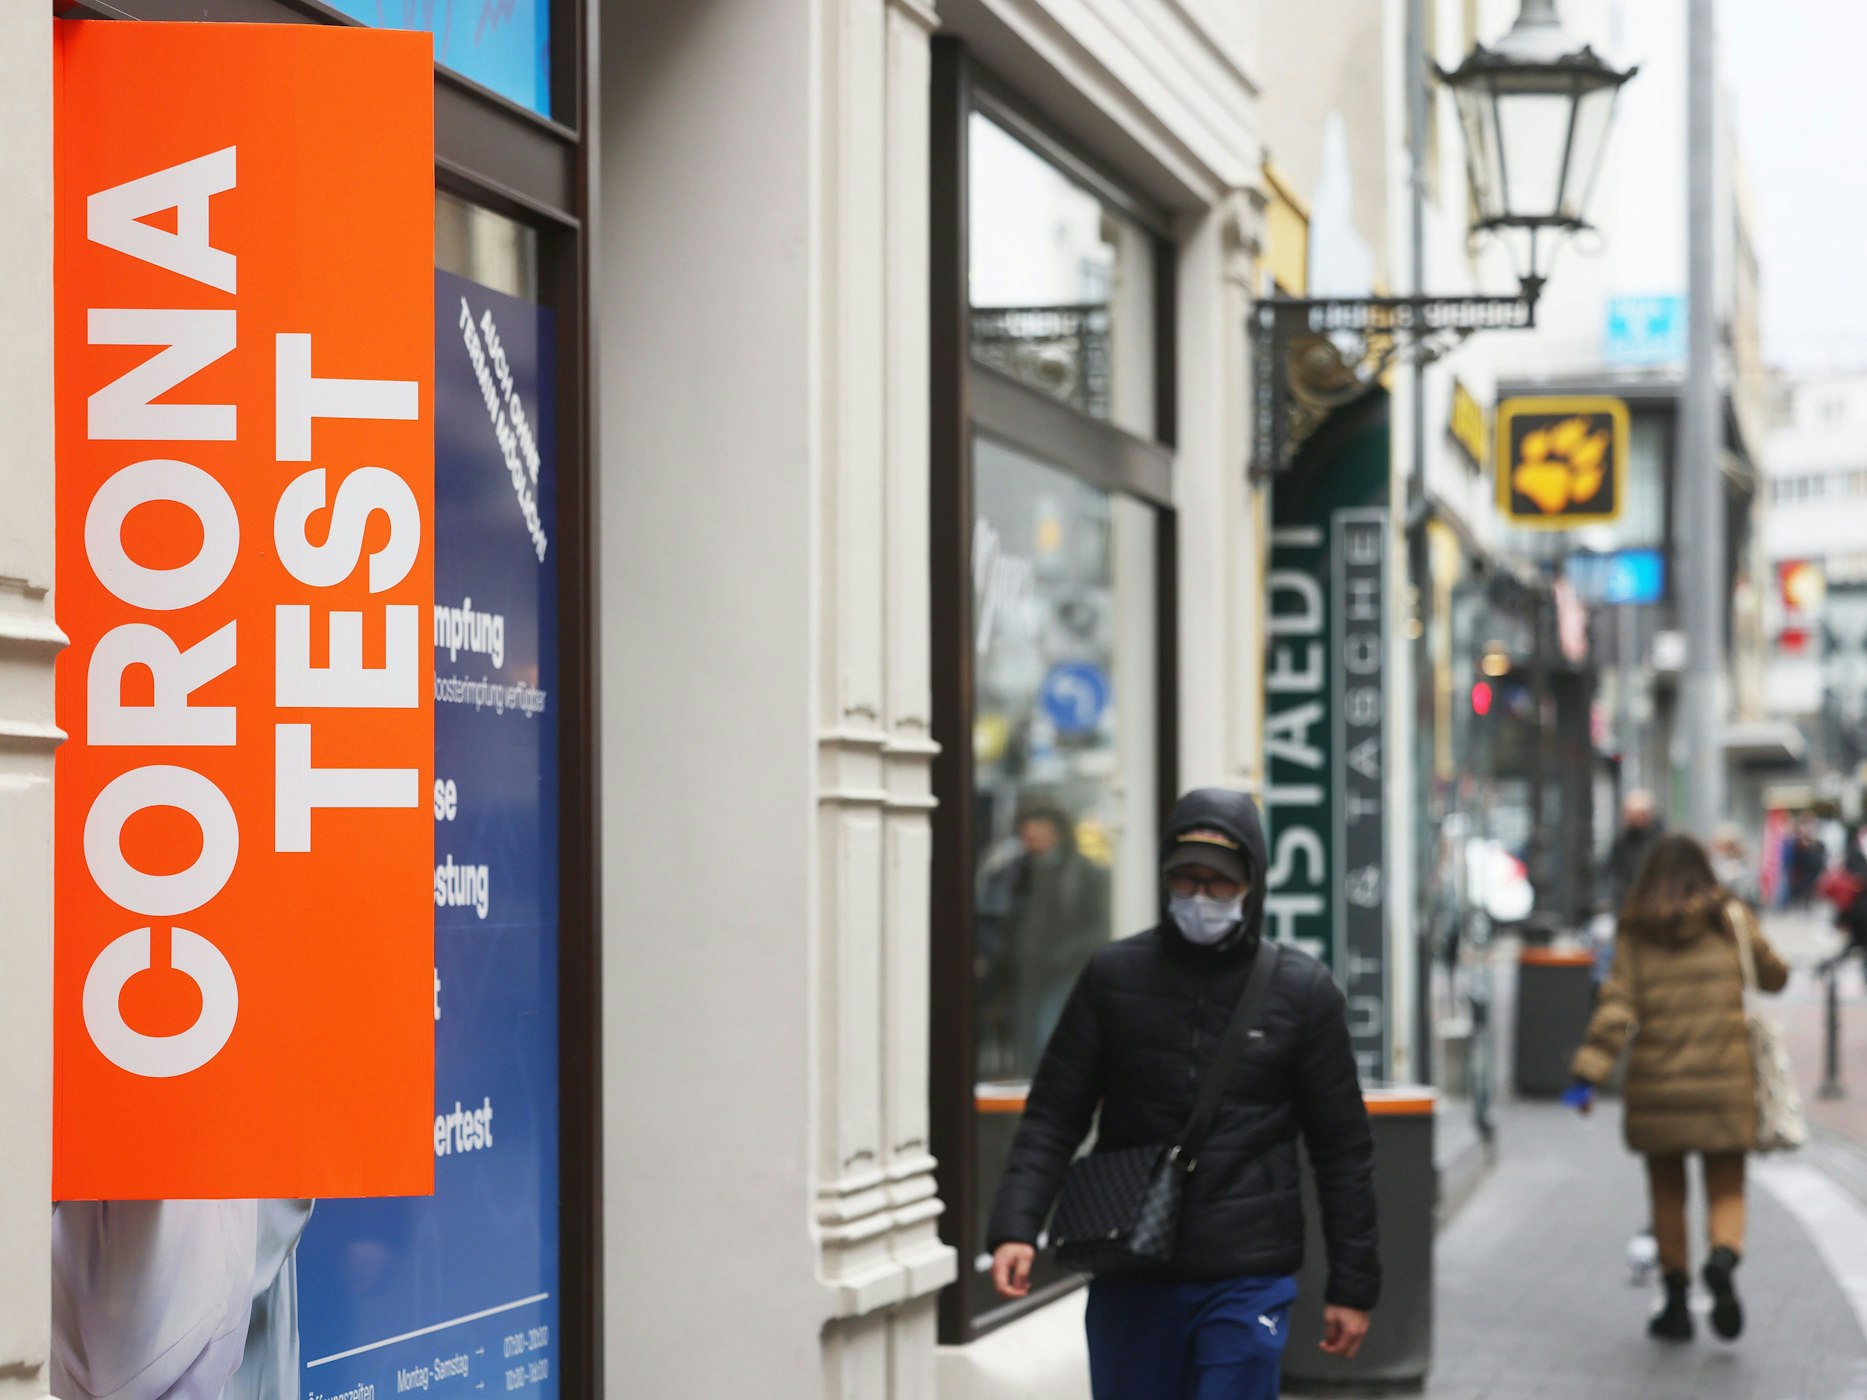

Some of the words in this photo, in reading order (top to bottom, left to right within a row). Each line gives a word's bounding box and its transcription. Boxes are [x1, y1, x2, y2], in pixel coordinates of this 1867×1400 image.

[459, 296, 501, 424] TERMIN
[480, 309, 514, 403] AUCH
[509, 392, 541, 484] OHNE
[84, 146, 240, 1078] CORONA
[274, 333, 421, 854] TEST
[1346, 528, 1383, 826] TASCHE
[434, 854, 489, 920] stung
[1346, 863, 1383, 908] &
[434, 1096, 493, 1157] ertest
[397, 1365, 429, 1392] Montag
[433, 1354, 469, 1382] Samstag
